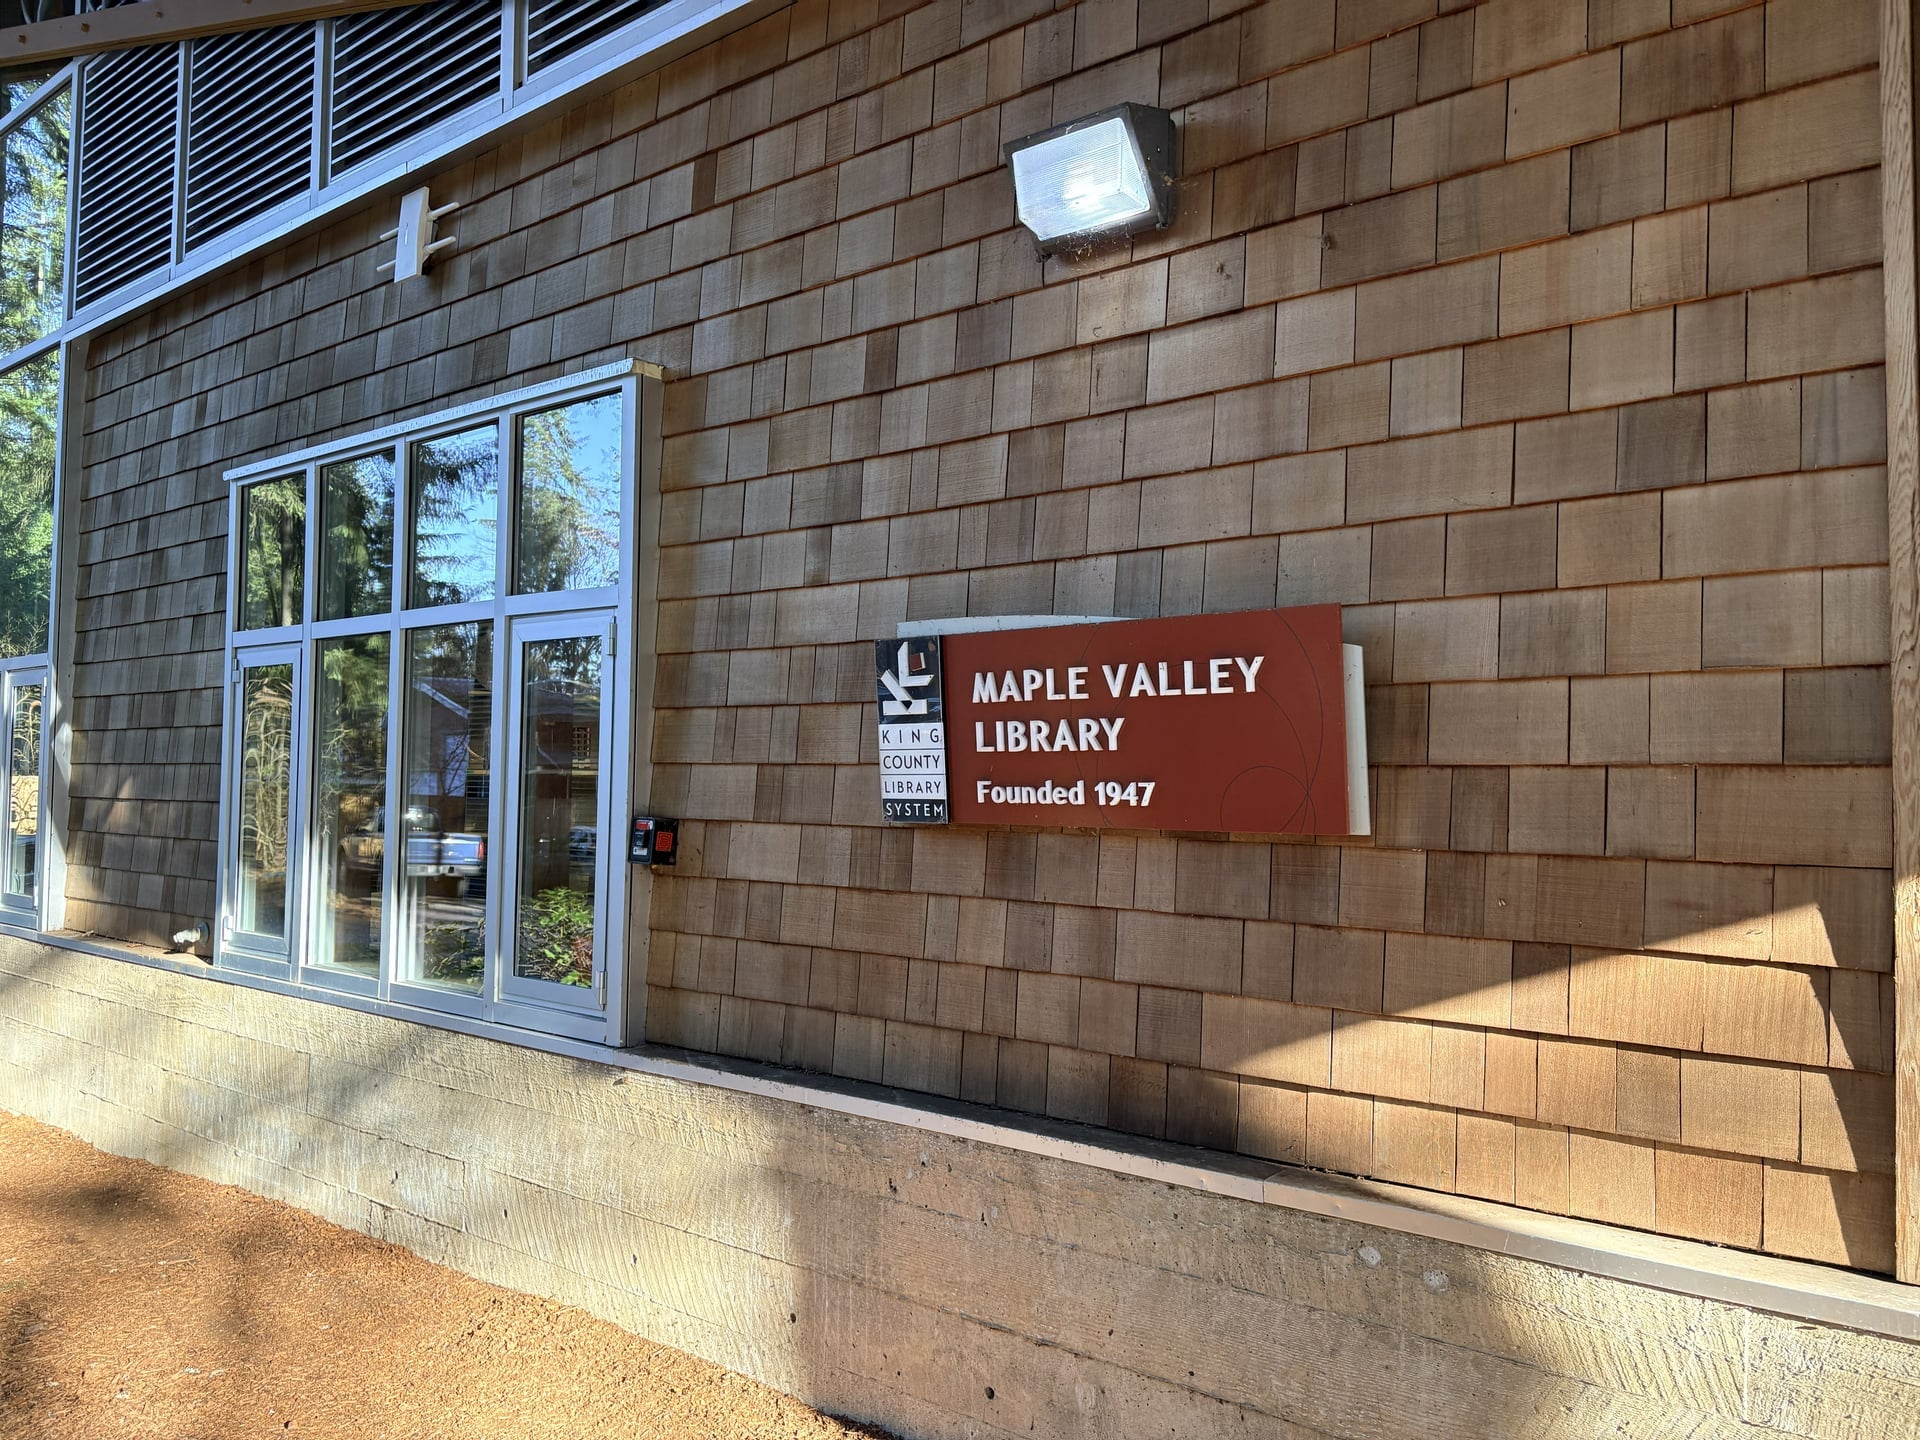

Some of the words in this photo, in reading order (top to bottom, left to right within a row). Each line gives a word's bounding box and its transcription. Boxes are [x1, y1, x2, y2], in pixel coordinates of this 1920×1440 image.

[972, 665, 1089, 704] MAPLE
[1102, 656, 1265, 698] VALLEY
[882, 728, 940, 744] KING
[975, 717, 1126, 753] LIBRARY
[883, 755, 941, 769] COUNTY
[884, 781, 941, 794] LIBRARY
[976, 779, 1085, 807] Founded
[1093, 781, 1156, 808] 1947
[886, 802, 944, 817] SYSTEM
